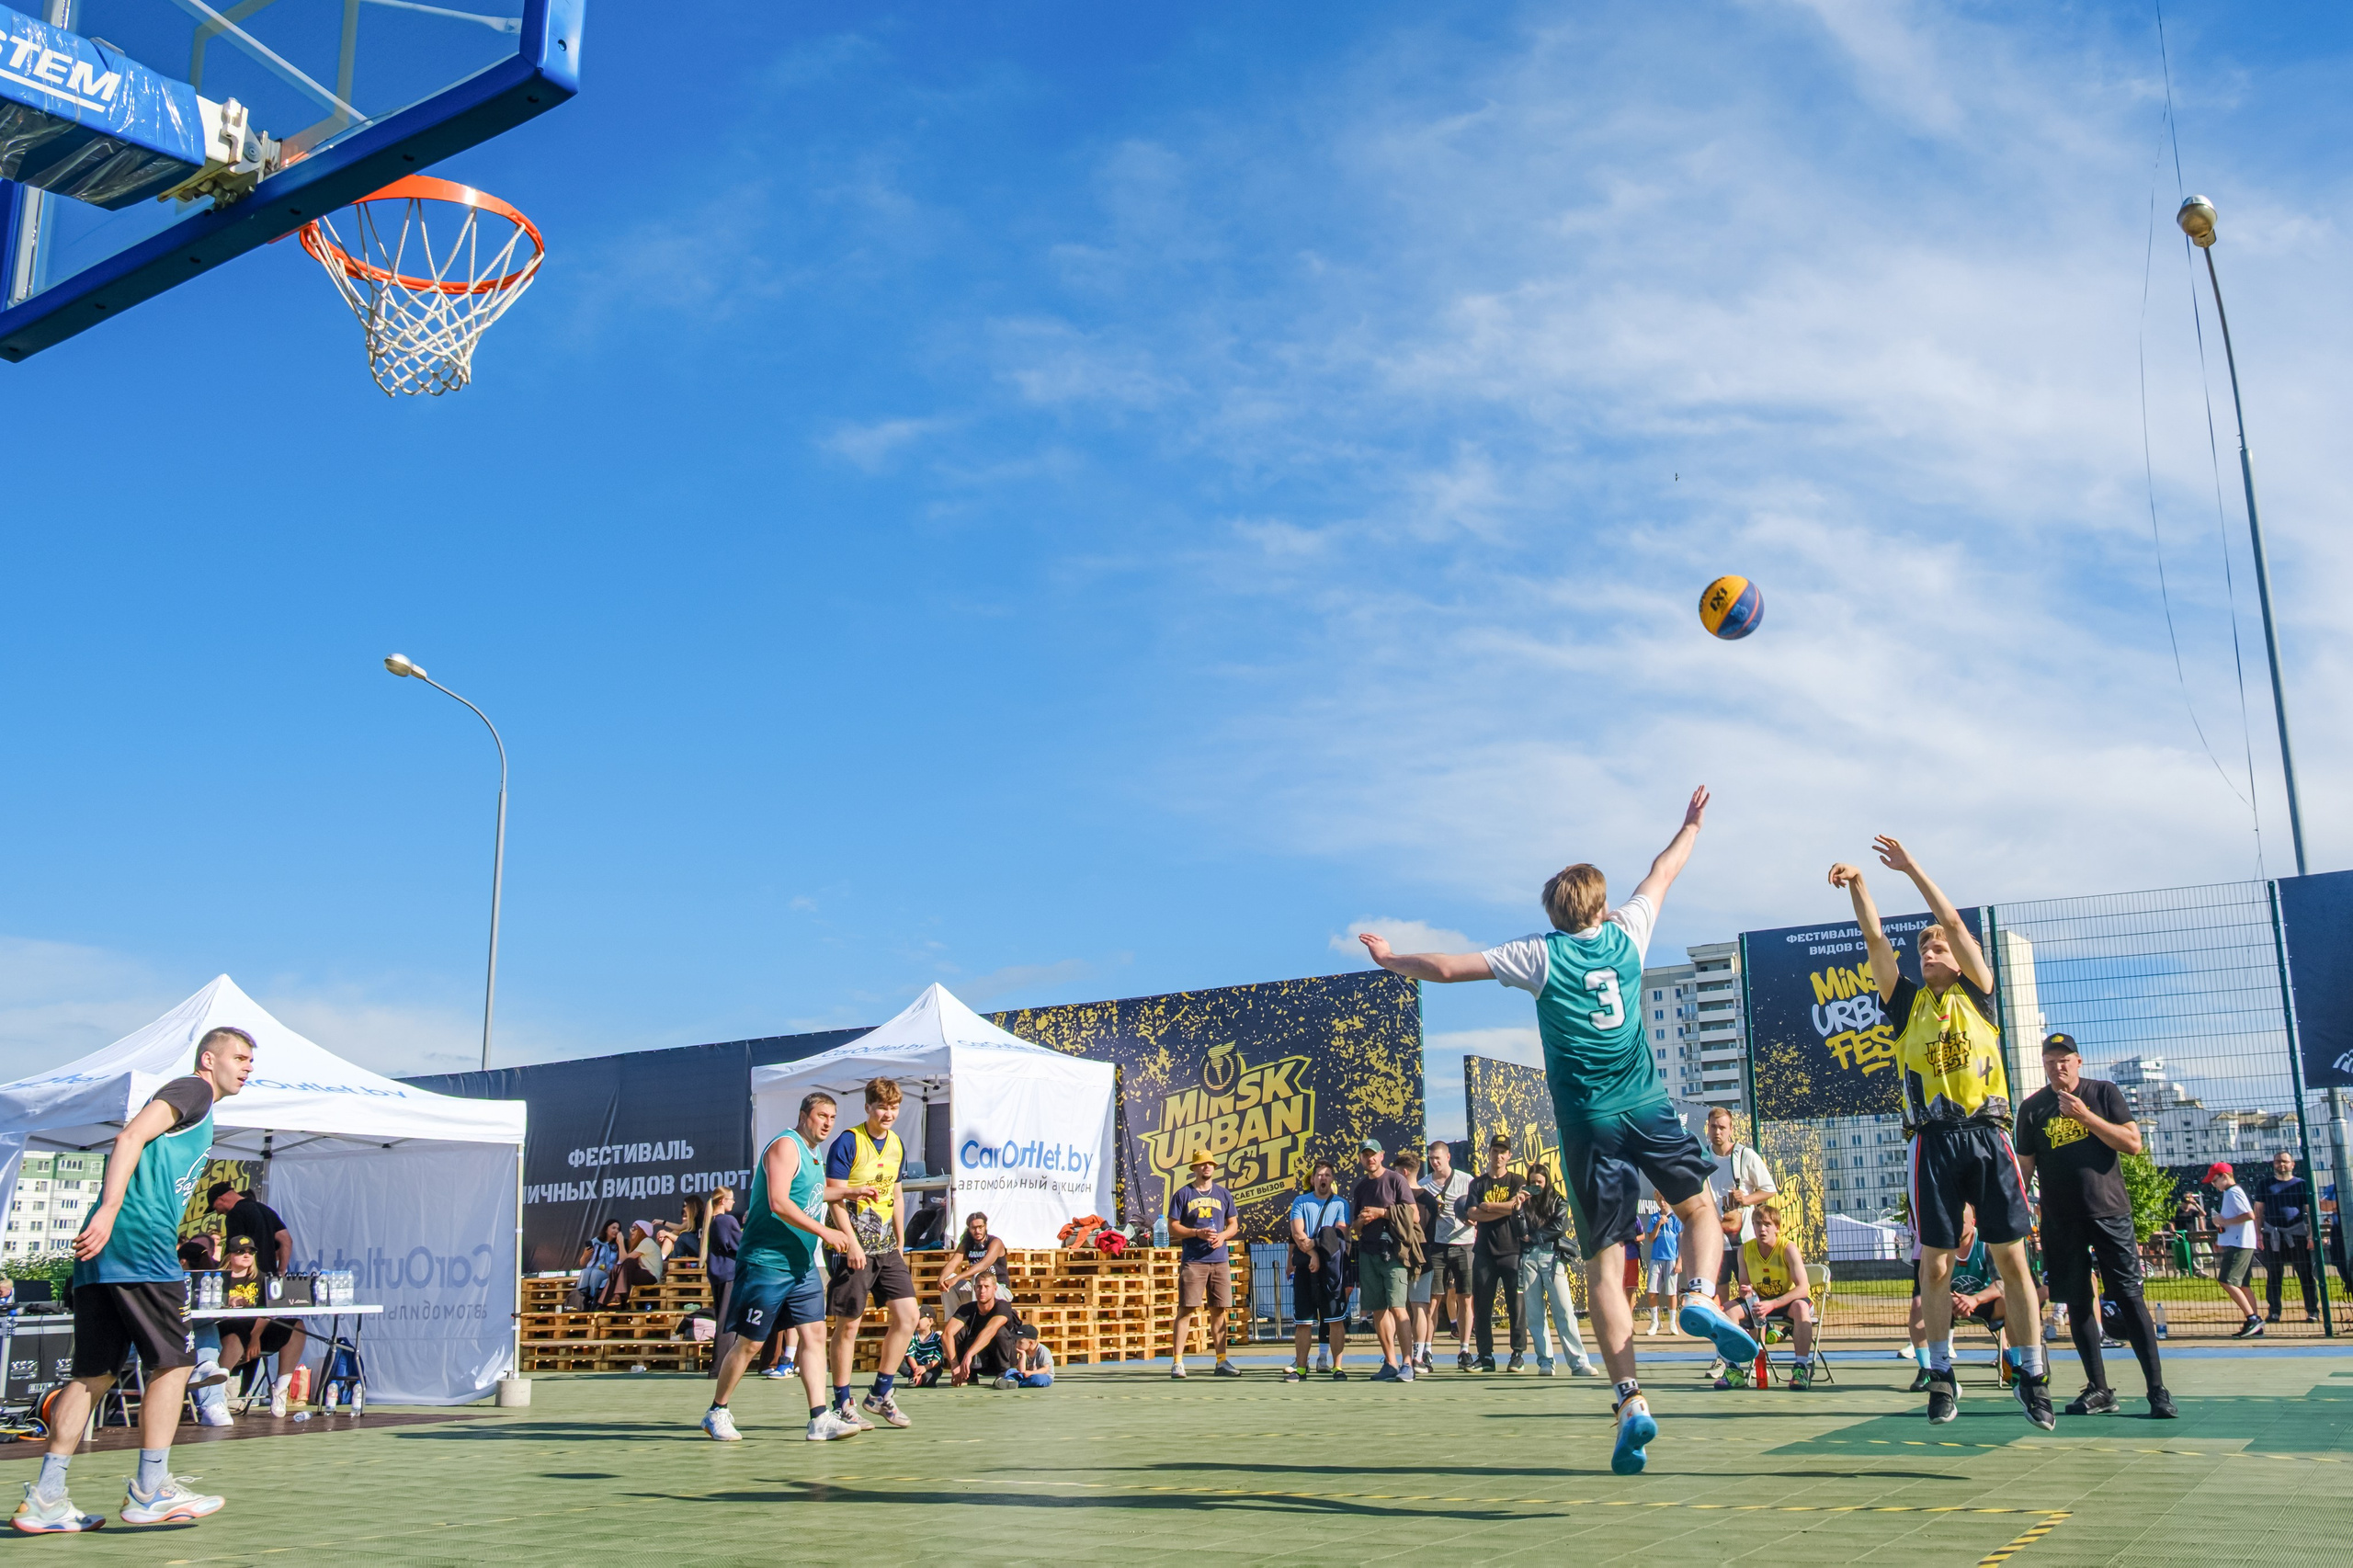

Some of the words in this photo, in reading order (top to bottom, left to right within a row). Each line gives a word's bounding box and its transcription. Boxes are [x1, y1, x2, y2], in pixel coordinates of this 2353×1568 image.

[0, 28, 121, 102] TEM
[1786, 927, 1863, 944] ФЕСТИВАЛЬ
[1881, 920, 1928, 934] ИЧНЫХ
[1809, 941, 1853, 956] ВИДОВ
[1856, 937, 1906, 950] СТА
[1810, 950, 1900, 1006] MiNS
[1582, 965, 1627, 1031] 3
[1812, 994, 1886, 1037] URBA
[1824, 1025, 1895, 1070] FES
[1927, 1040, 1970, 1064] URBAN
[1934, 1053, 1968, 1075] FEST
[1976, 1056, 1993, 1086] 4
[244, 1079, 406, 1098] rOutlet.by
[1165, 1061, 1297, 1131] MINSK
[1152, 1094, 1303, 1169] URBAN
[2048, 1120, 2081, 1135] URBA
[568, 1140, 694, 1167] ФЕСТИВАЛЬ
[523, 1180, 597, 1205] ИЧНЫХ
[603, 1175, 675, 1199] ВИДОВ
[680, 1169, 753, 1194] СПОРТ
[958, 1176, 1048, 1191] автомобиный
[1051, 1180, 1092, 1195] акцион
[1232, 1189, 1255, 1200] САЕТ
[1256, 1181, 1285, 1195] ВЫЗОВ
[1198, 1207, 1212, 1218] M
[270, 1281, 282, 1300] 0
[745, 1308, 763, 1325] 12
